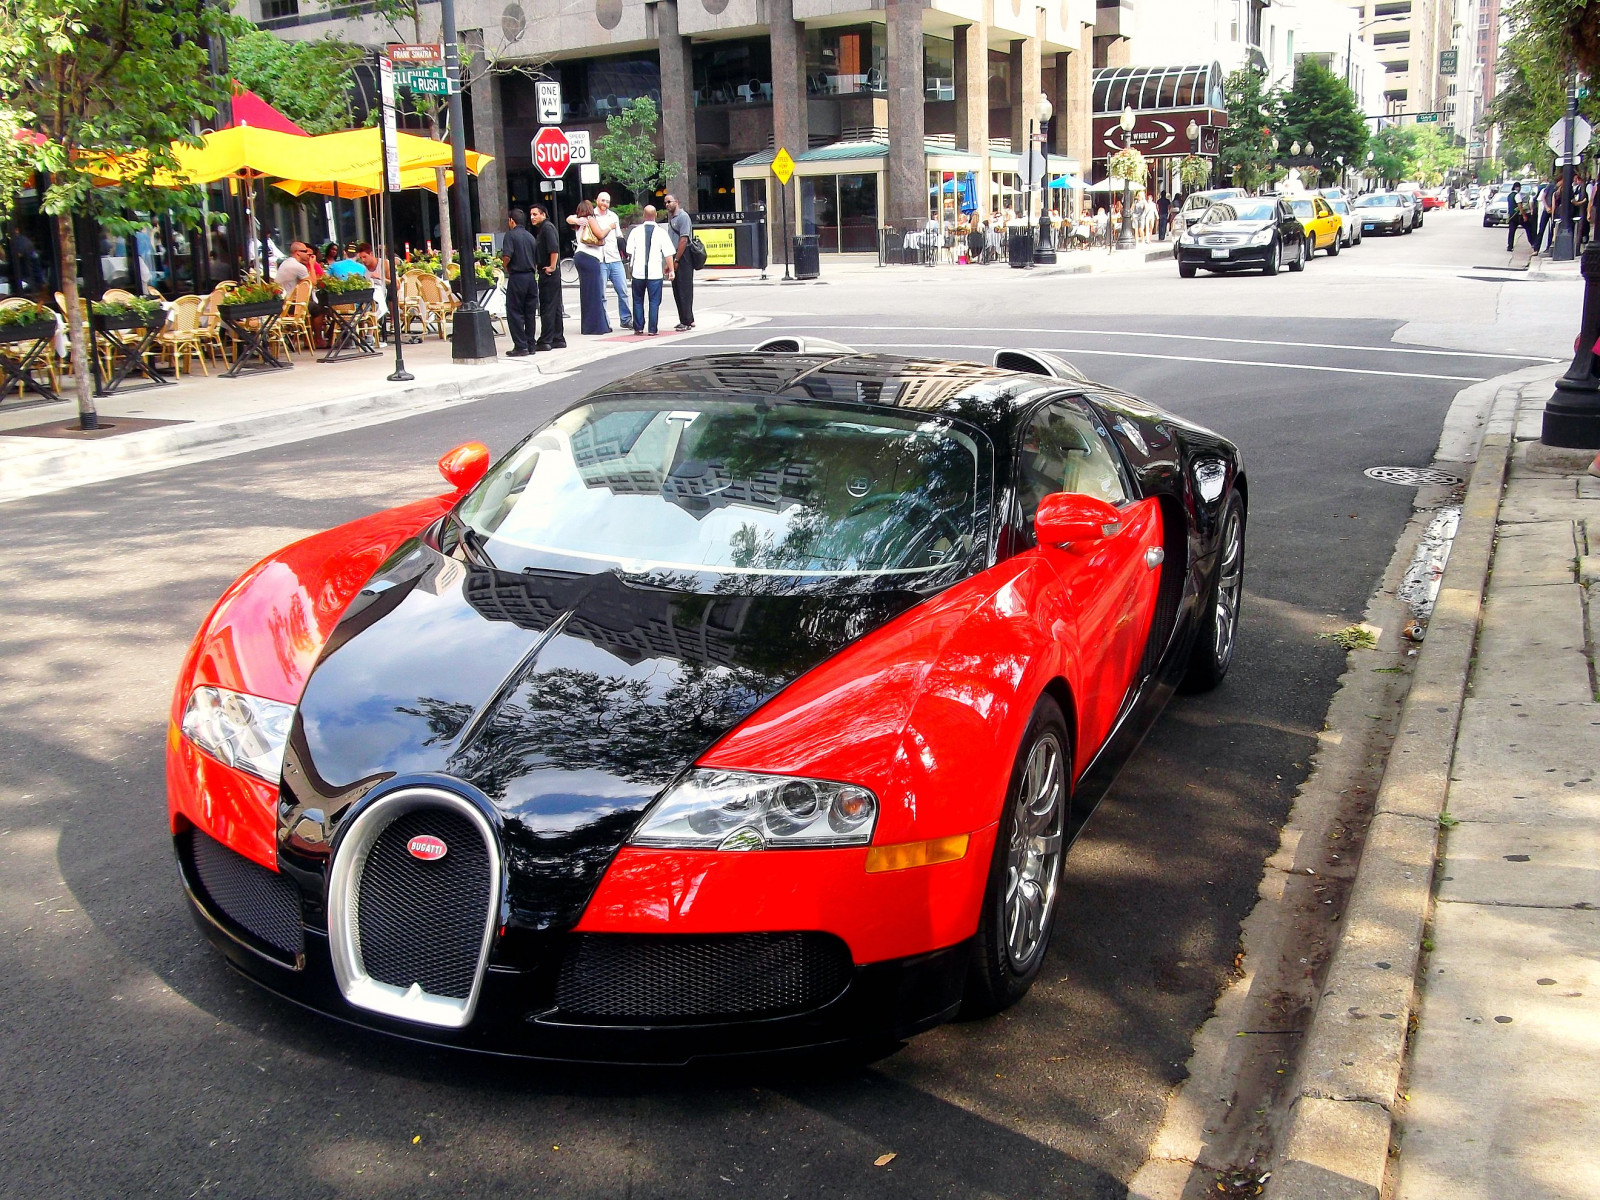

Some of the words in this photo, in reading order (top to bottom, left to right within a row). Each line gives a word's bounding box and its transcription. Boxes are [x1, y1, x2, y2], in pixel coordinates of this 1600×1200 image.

[394, 50, 410, 59] FRANK
[412, 50, 432, 59] SINATRA
[418, 78, 440, 92] RUSH
[541, 86, 557, 96] ONE
[541, 97, 558, 107] WAY
[1133, 131, 1159, 140] WHISKEY
[537, 143, 568, 162] STOP
[570, 146, 586, 159] 20
[411, 842, 442, 855] BUGATTI
